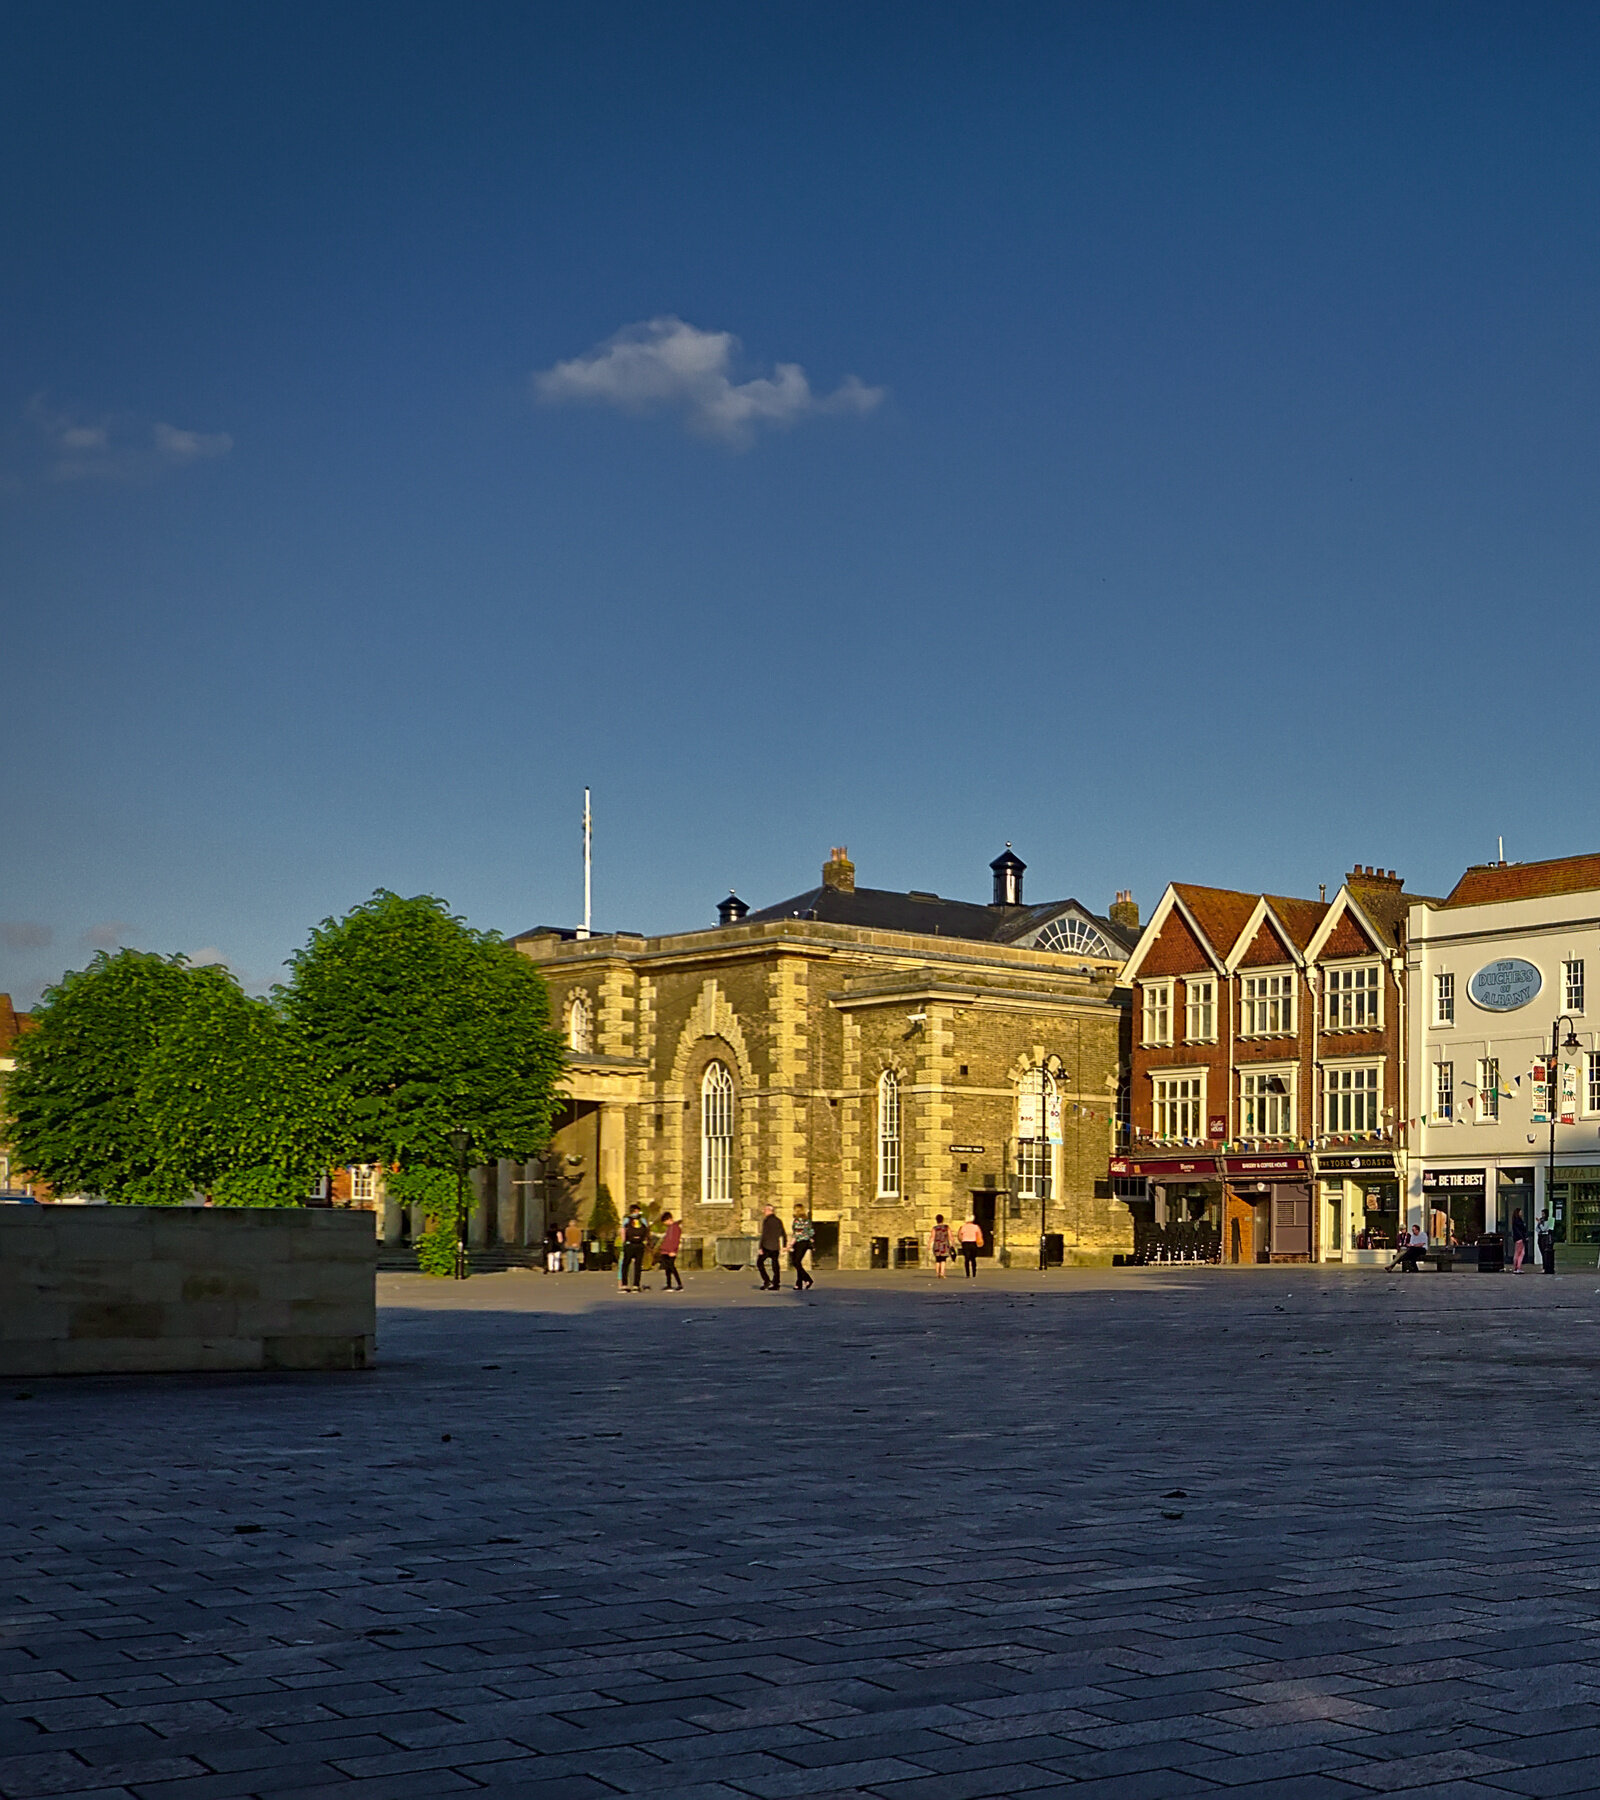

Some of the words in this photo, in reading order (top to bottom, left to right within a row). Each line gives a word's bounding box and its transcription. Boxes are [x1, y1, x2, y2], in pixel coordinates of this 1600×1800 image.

[1478, 968, 1534, 987] DUCHESS
[1500, 985, 1512, 993] OF
[1480, 986, 1530, 1006] ALBANY
[1330, 1159, 1351, 1167] YORK
[1361, 1158, 1386, 1166] ROAST
[1438, 1175, 1449, 1186] BE
[1450, 1174, 1464, 1186] THE
[1464, 1174, 1484, 1185] BEST
